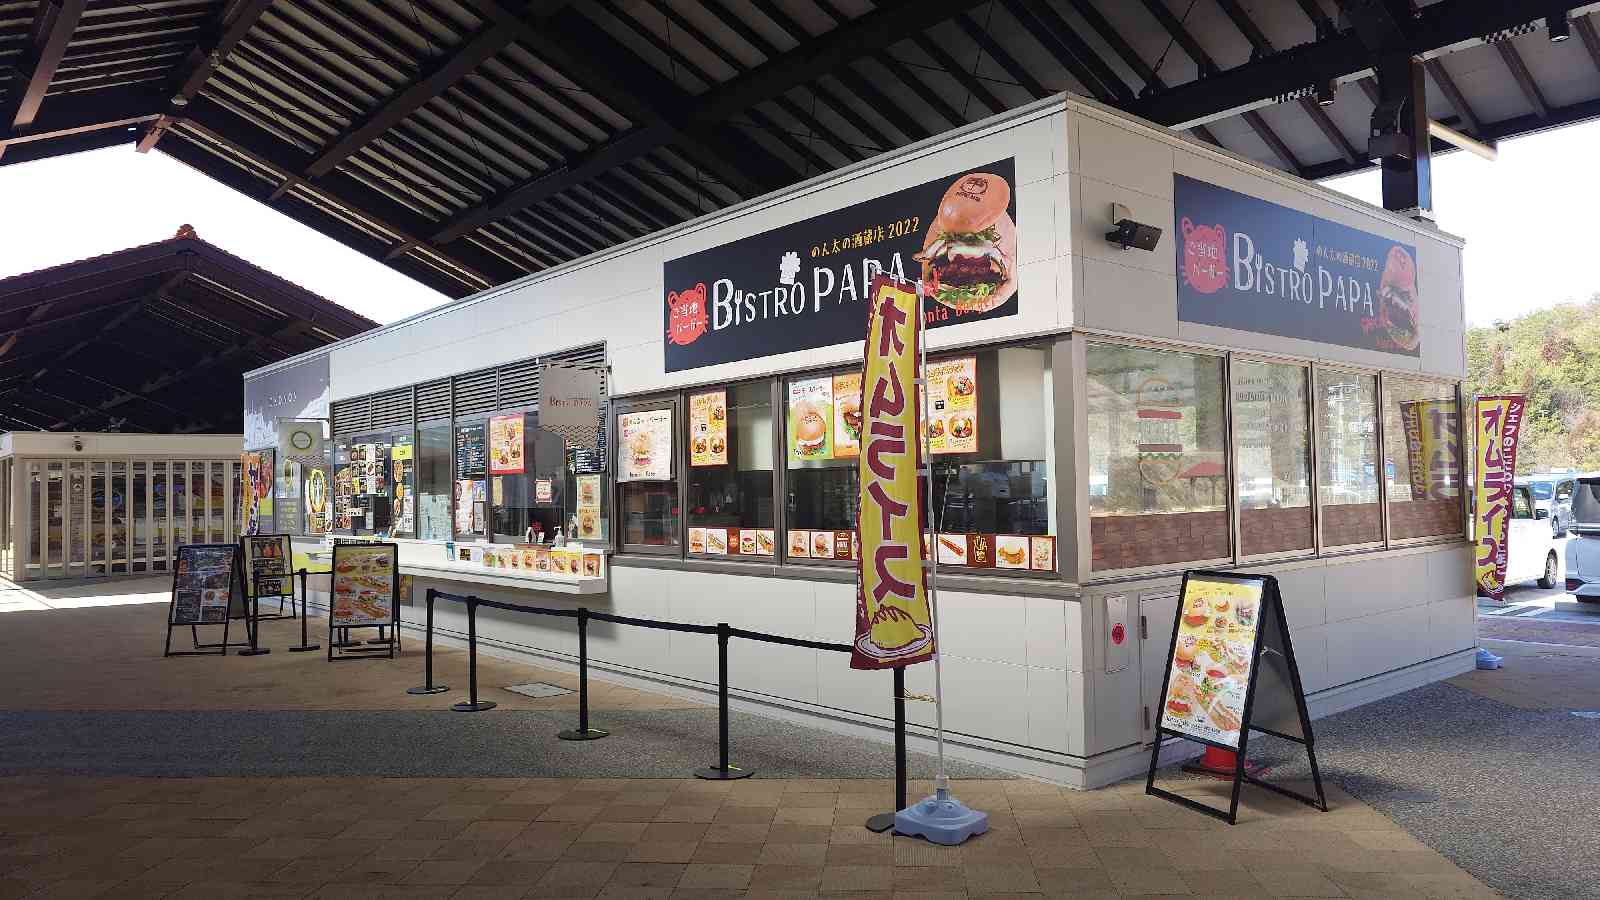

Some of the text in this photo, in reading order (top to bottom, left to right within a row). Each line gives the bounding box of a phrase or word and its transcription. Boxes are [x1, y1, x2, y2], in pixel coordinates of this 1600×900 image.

[888, 216, 920, 239] 2022
[812, 252, 906, 313] PAPA
[1192, 263, 1225, 281] バーガー
[1318, 266, 1374, 316] PAPA
[672, 302, 699, 319] ご当地
[675, 319, 703, 335] バーガー
[1478, 404, 1504, 566] オムライス
